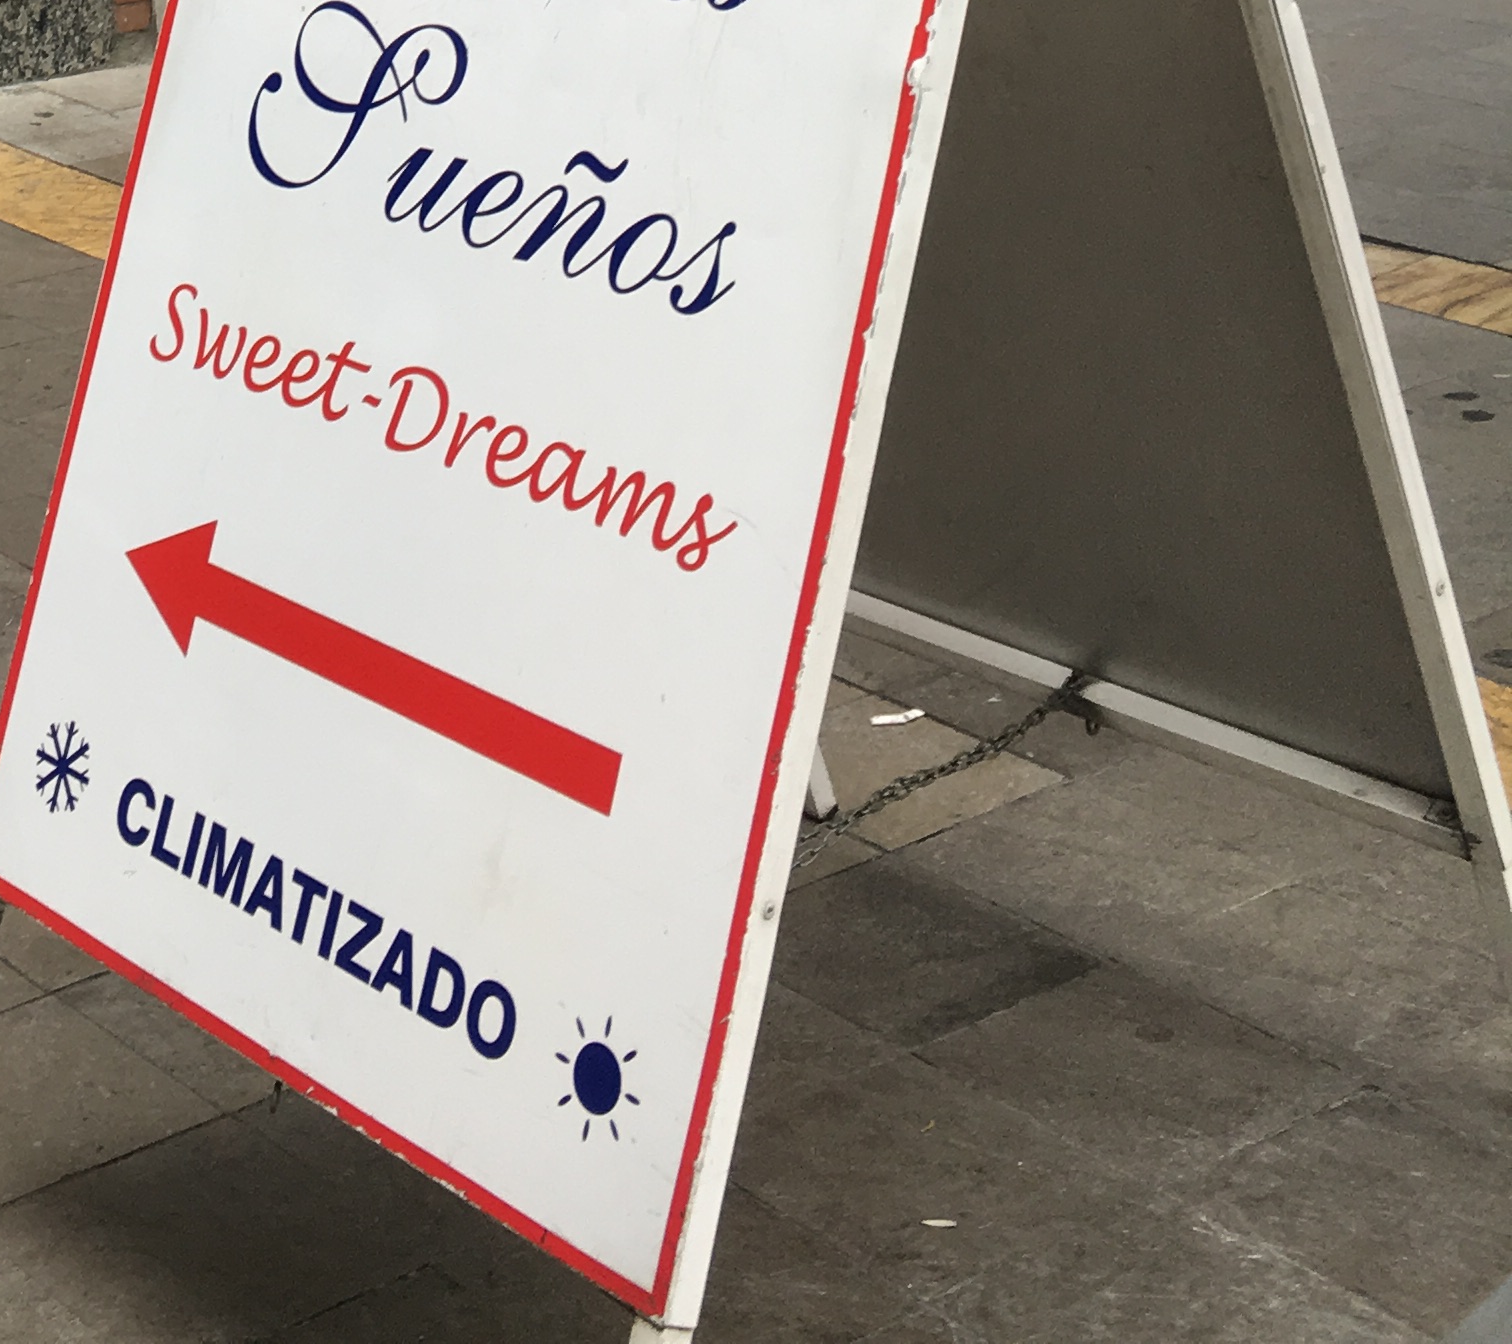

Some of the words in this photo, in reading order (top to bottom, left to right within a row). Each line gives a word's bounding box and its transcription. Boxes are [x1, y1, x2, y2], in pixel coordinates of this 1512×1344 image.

[247, 0, 737, 315] Sueños
[149, 282, 737, 573] Sweet-Dreams
[115, 777, 518, 1060] CLIMATIZADO
